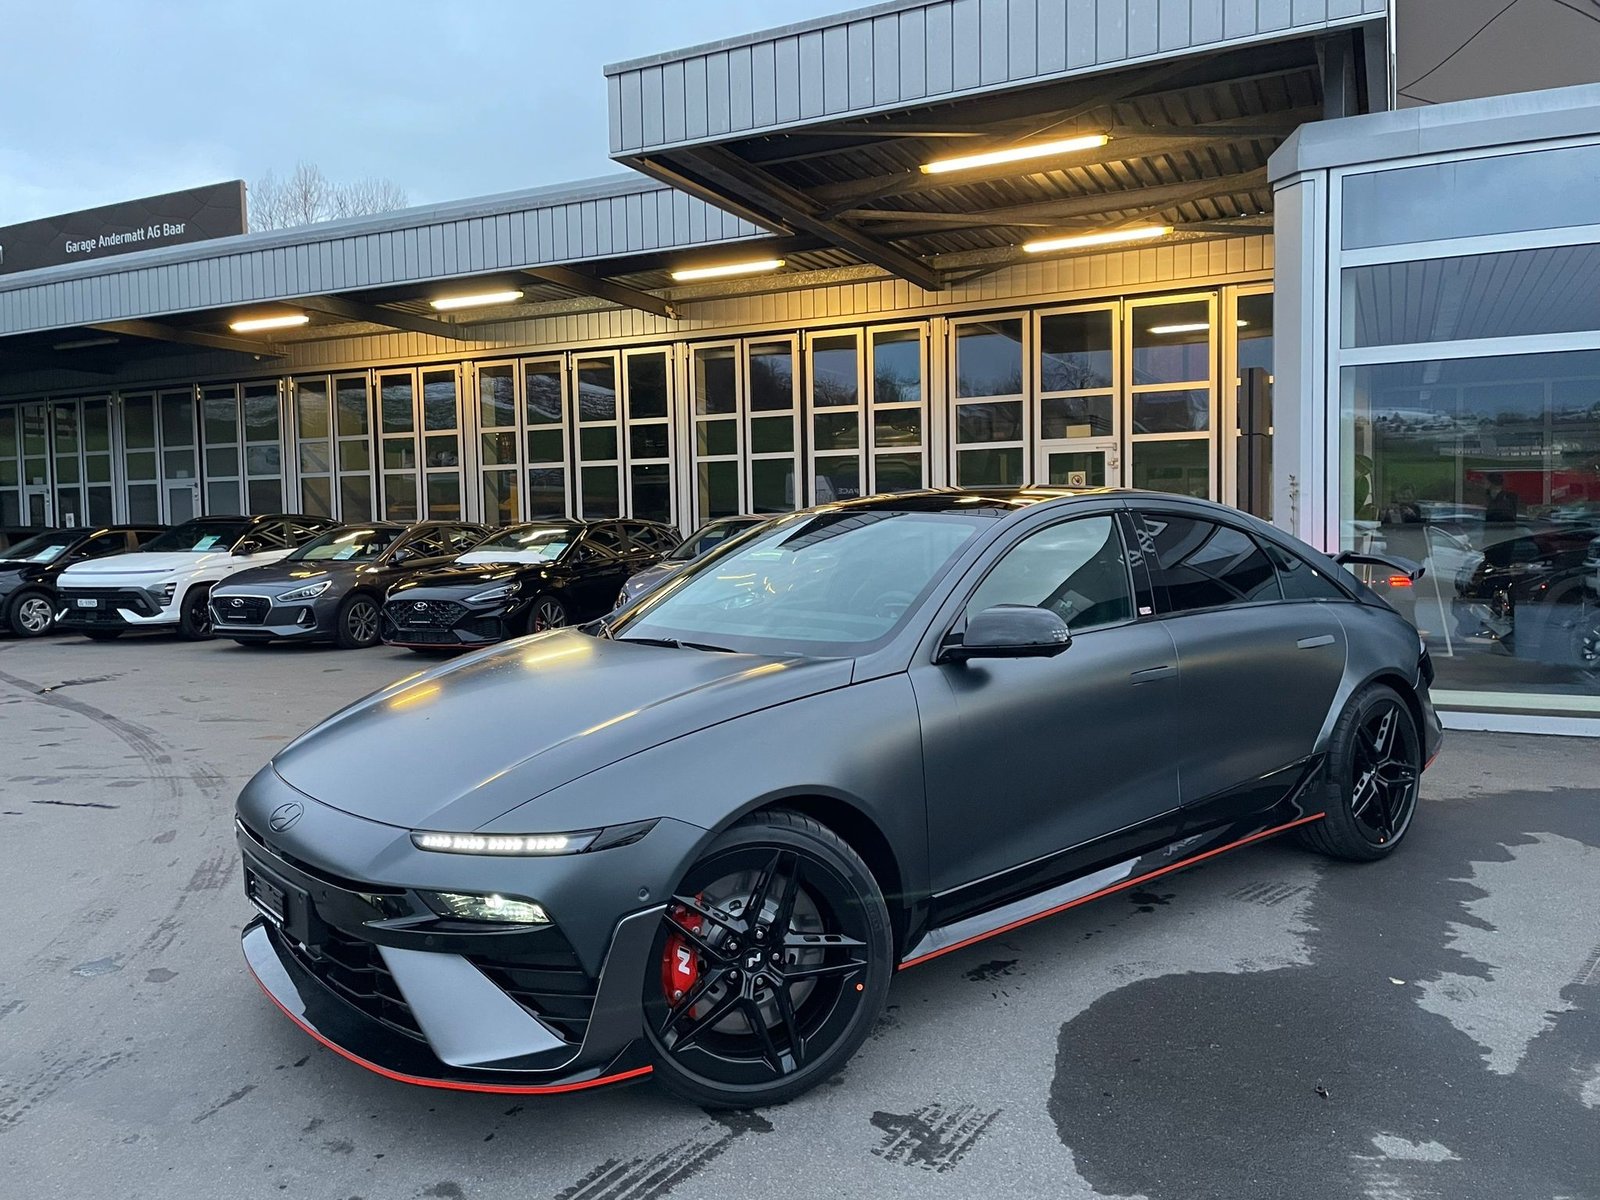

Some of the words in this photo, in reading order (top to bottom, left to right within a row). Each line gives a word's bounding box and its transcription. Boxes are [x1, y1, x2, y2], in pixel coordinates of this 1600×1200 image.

[66, 240, 96, 253] Garage
[99, 228, 145, 247] Andermatt
[148, 225, 161, 239] AG
[164, 223, 186, 236] Baar
